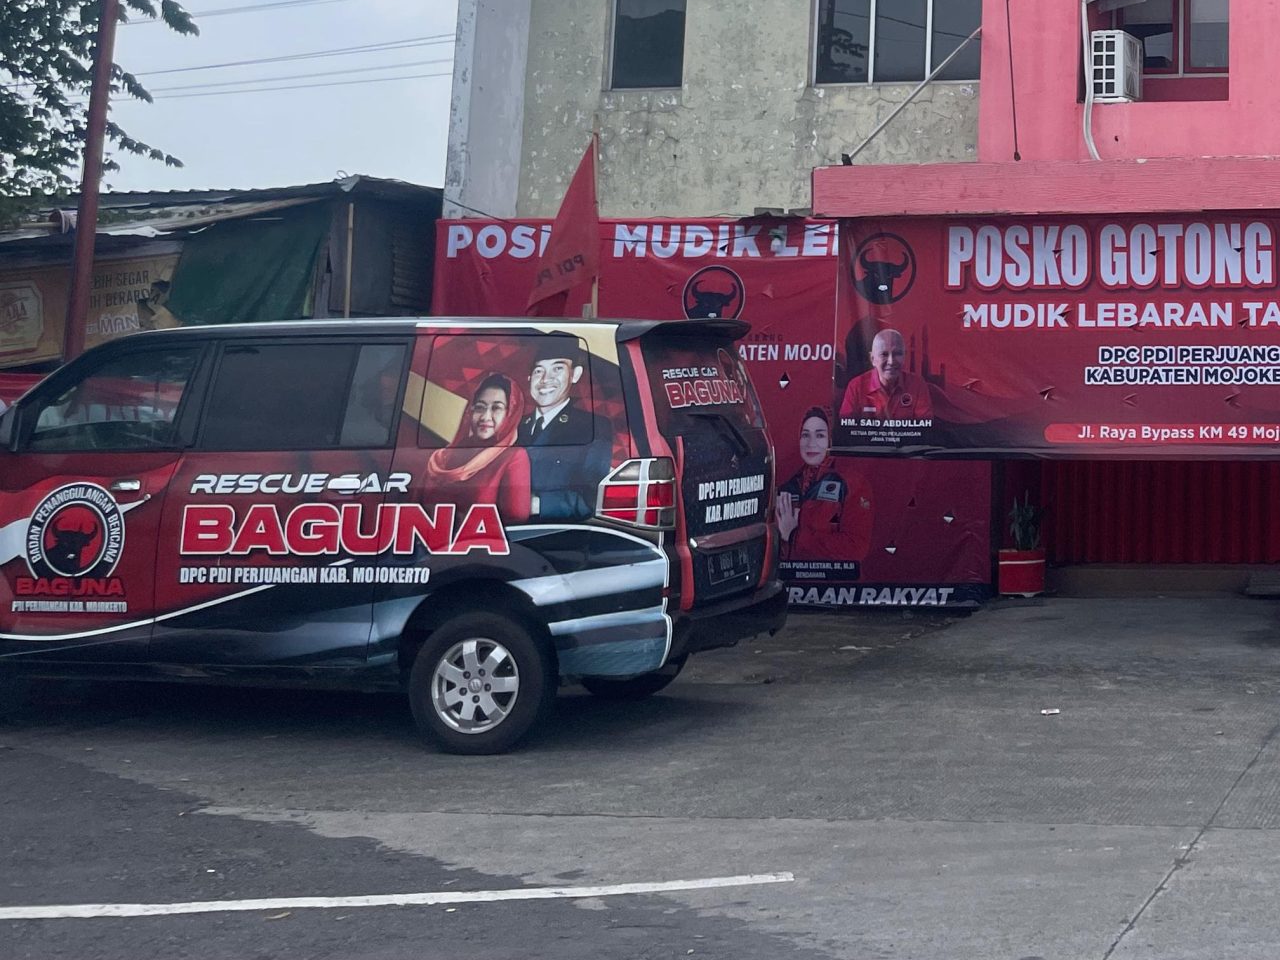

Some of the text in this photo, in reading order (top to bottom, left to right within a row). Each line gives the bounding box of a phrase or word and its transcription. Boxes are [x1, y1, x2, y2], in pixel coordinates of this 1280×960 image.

[613, 224, 762, 258] MUDIK
[774, 224, 839, 257] LE
[947, 225, 1089, 288] POSKO
[1099, 222, 1273, 287] GOTONG
[116, 270, 149, 287] SEGAR
[963, 303, 1070, 328] MUDIK
[1077, 302, 1233, 328] LEBARAN
[739, 343, 835, 361] ATEN MOJO
[1099, 346, 1140, 364] DPC
[1142, 346, 1176, 364] PDI
[662, 367, 718, 380] RESCUE CAR
[1085, 366, 1201, 385] KABUPATEN
[664, 379, 744, 409] BAGUNA
[840, 418, 933, 428] HM. SAID ABDULLAH
[1077, 425, 1096, 439] Jl.
[1100, 426, 1138, 441] Raya
[1141, 426, 1195, 442] Bypass
[1199, 426, 1223, 439] KM
[1227, 425, 1248, 439] 49
[190, 473, 330, 494] RESCUE
[698, 474, 765, 501] DPC PDI PERJUANGAN
[705, 497, 759, 524] KAB. MOJOKERTO
[29, 487, 121, 564] BADAN PENANGGULANGAN BENCANA
[180, 503, 510, 556] BAGUNA
[180, 566, 431, 584] DPC PDI PERJUANGAN KAB. MOJOKERTO
[786, 587, 955, 606] RAAN RAKYAT
